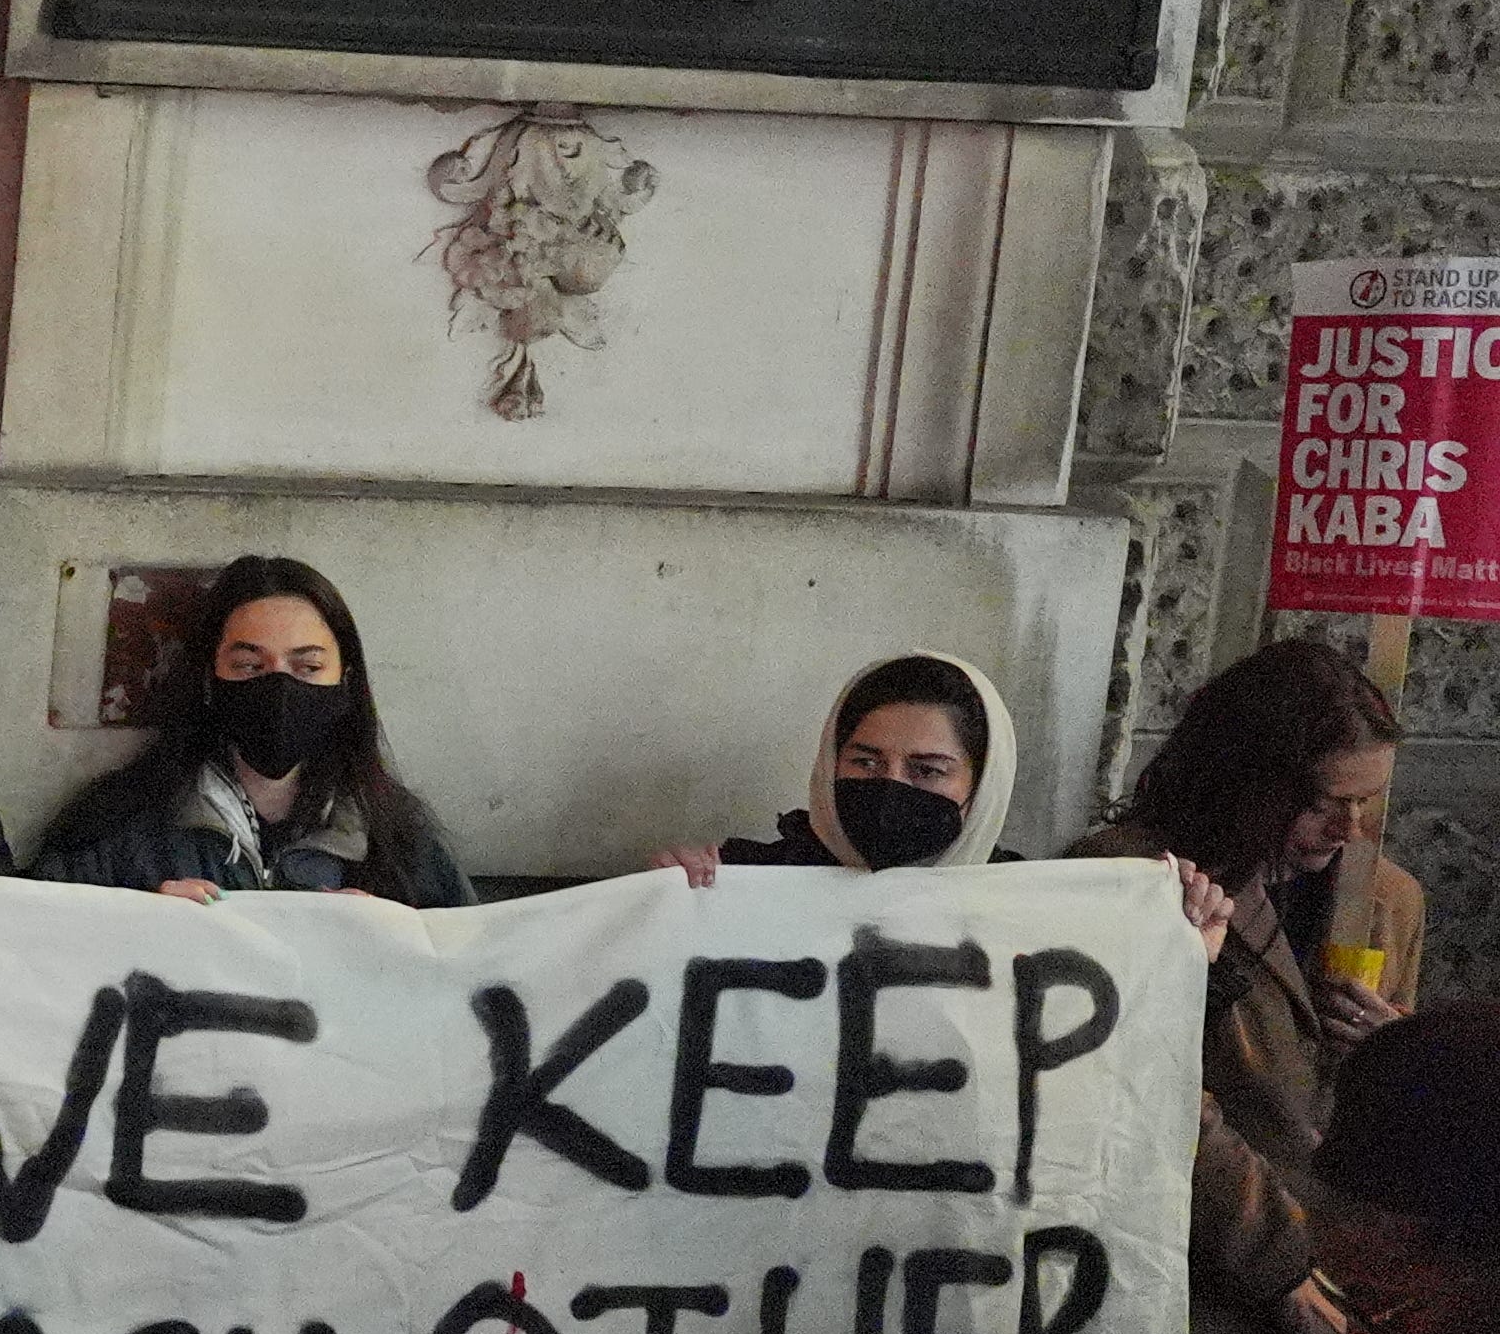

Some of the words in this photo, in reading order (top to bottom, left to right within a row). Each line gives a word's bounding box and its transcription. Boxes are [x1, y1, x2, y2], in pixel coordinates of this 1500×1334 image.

[1392, 268, 1460, 288] STAND
[1468, 269, 1499, 288] UP
[1393, 289, 1416, 308] TO
[1295, 382, 1406, 435] FOR
[1291, 439, 1468, 494] CHRIS
[1286, 494, 1446, 549] KABA
[1284, 550, 1349, 575] Black
[1354, 552, 1424, 578] Lives
[450, 921, 1121, 1212] KEEP
